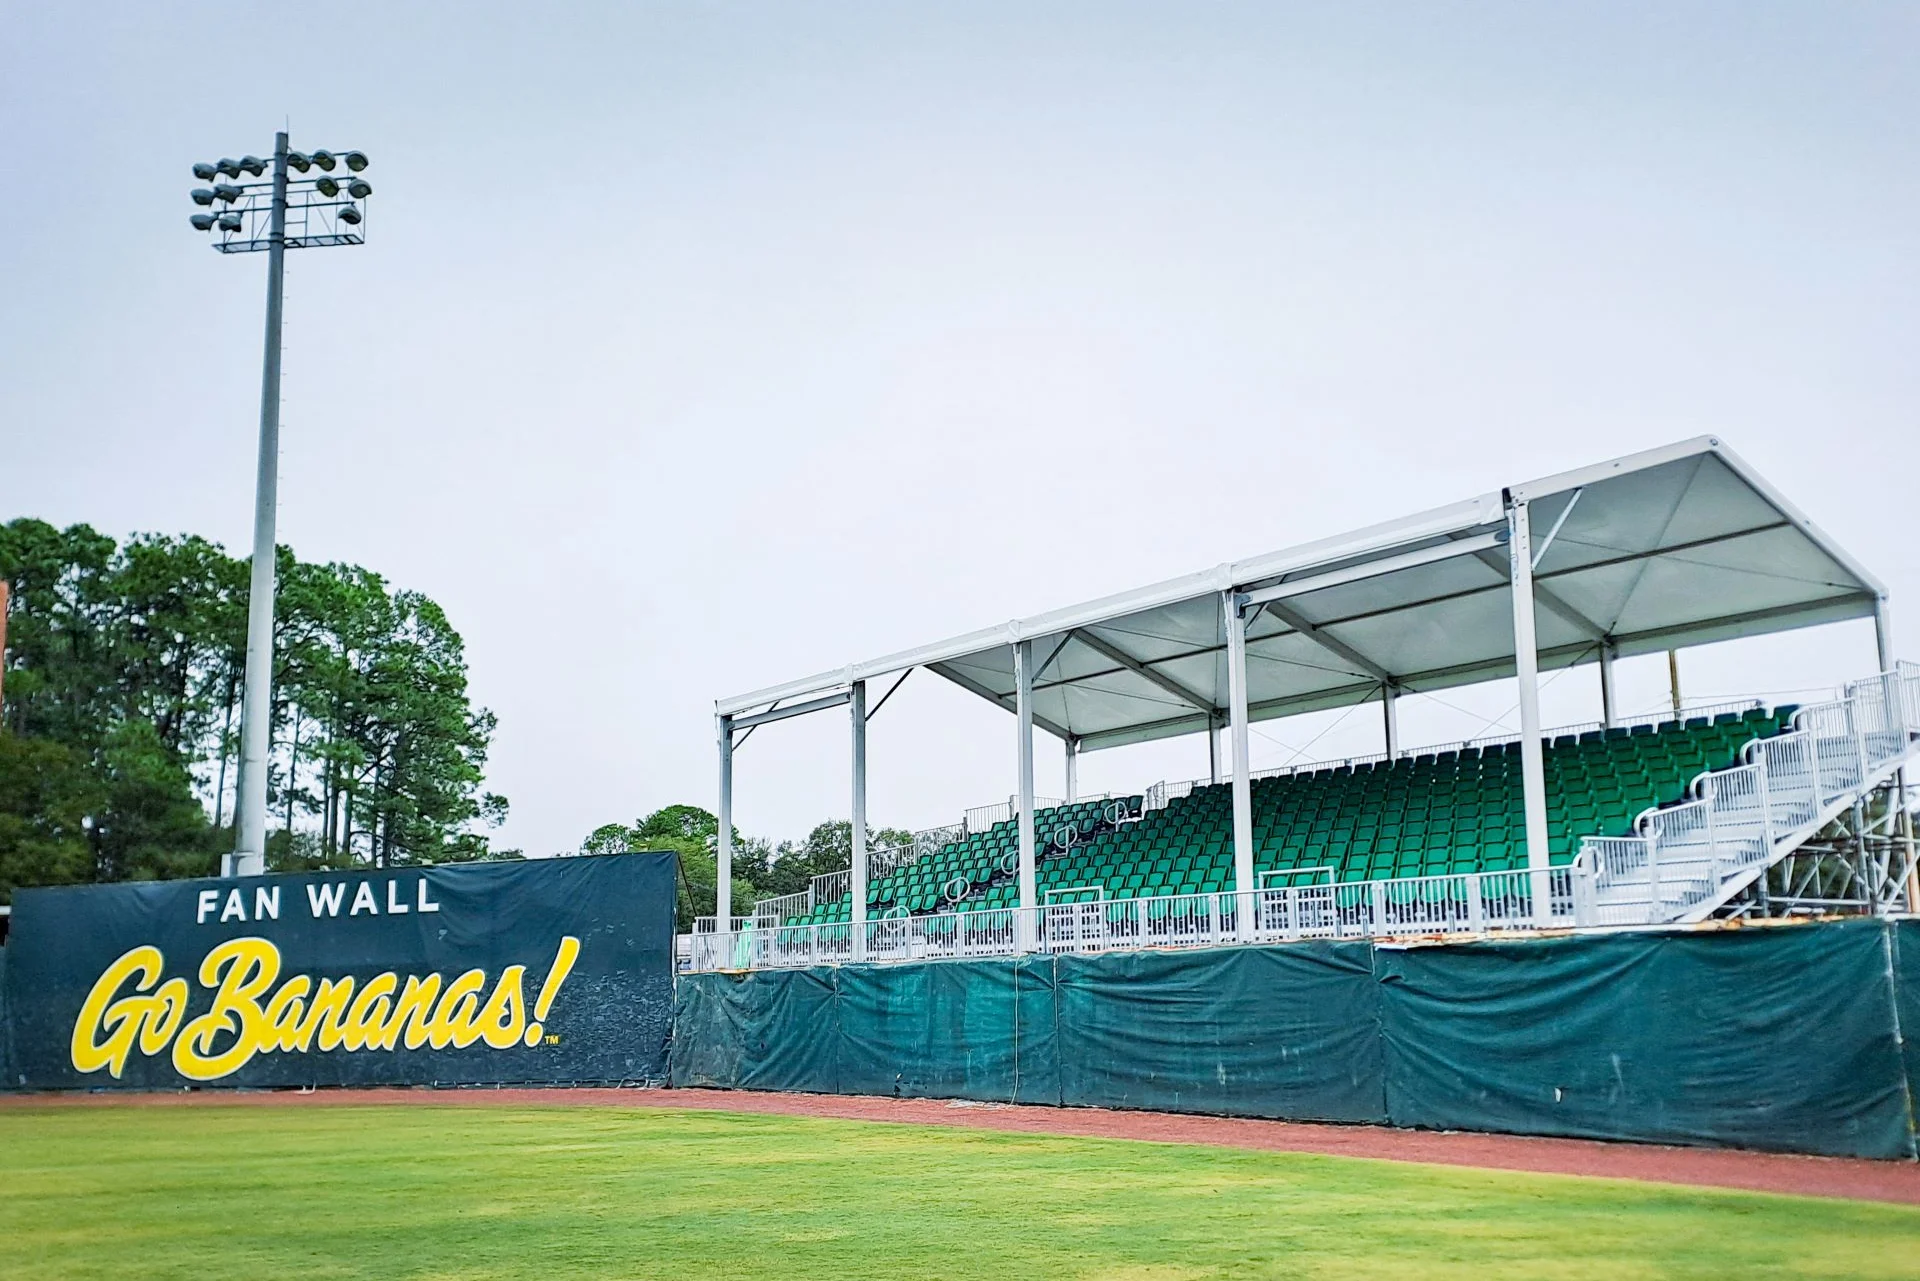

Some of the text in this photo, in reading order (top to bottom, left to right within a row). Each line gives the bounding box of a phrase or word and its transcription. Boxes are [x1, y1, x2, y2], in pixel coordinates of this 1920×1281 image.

[196, 878, 440, 924] FAN WALL
[71, 936, 581, 1081] Go Bananas! TM
